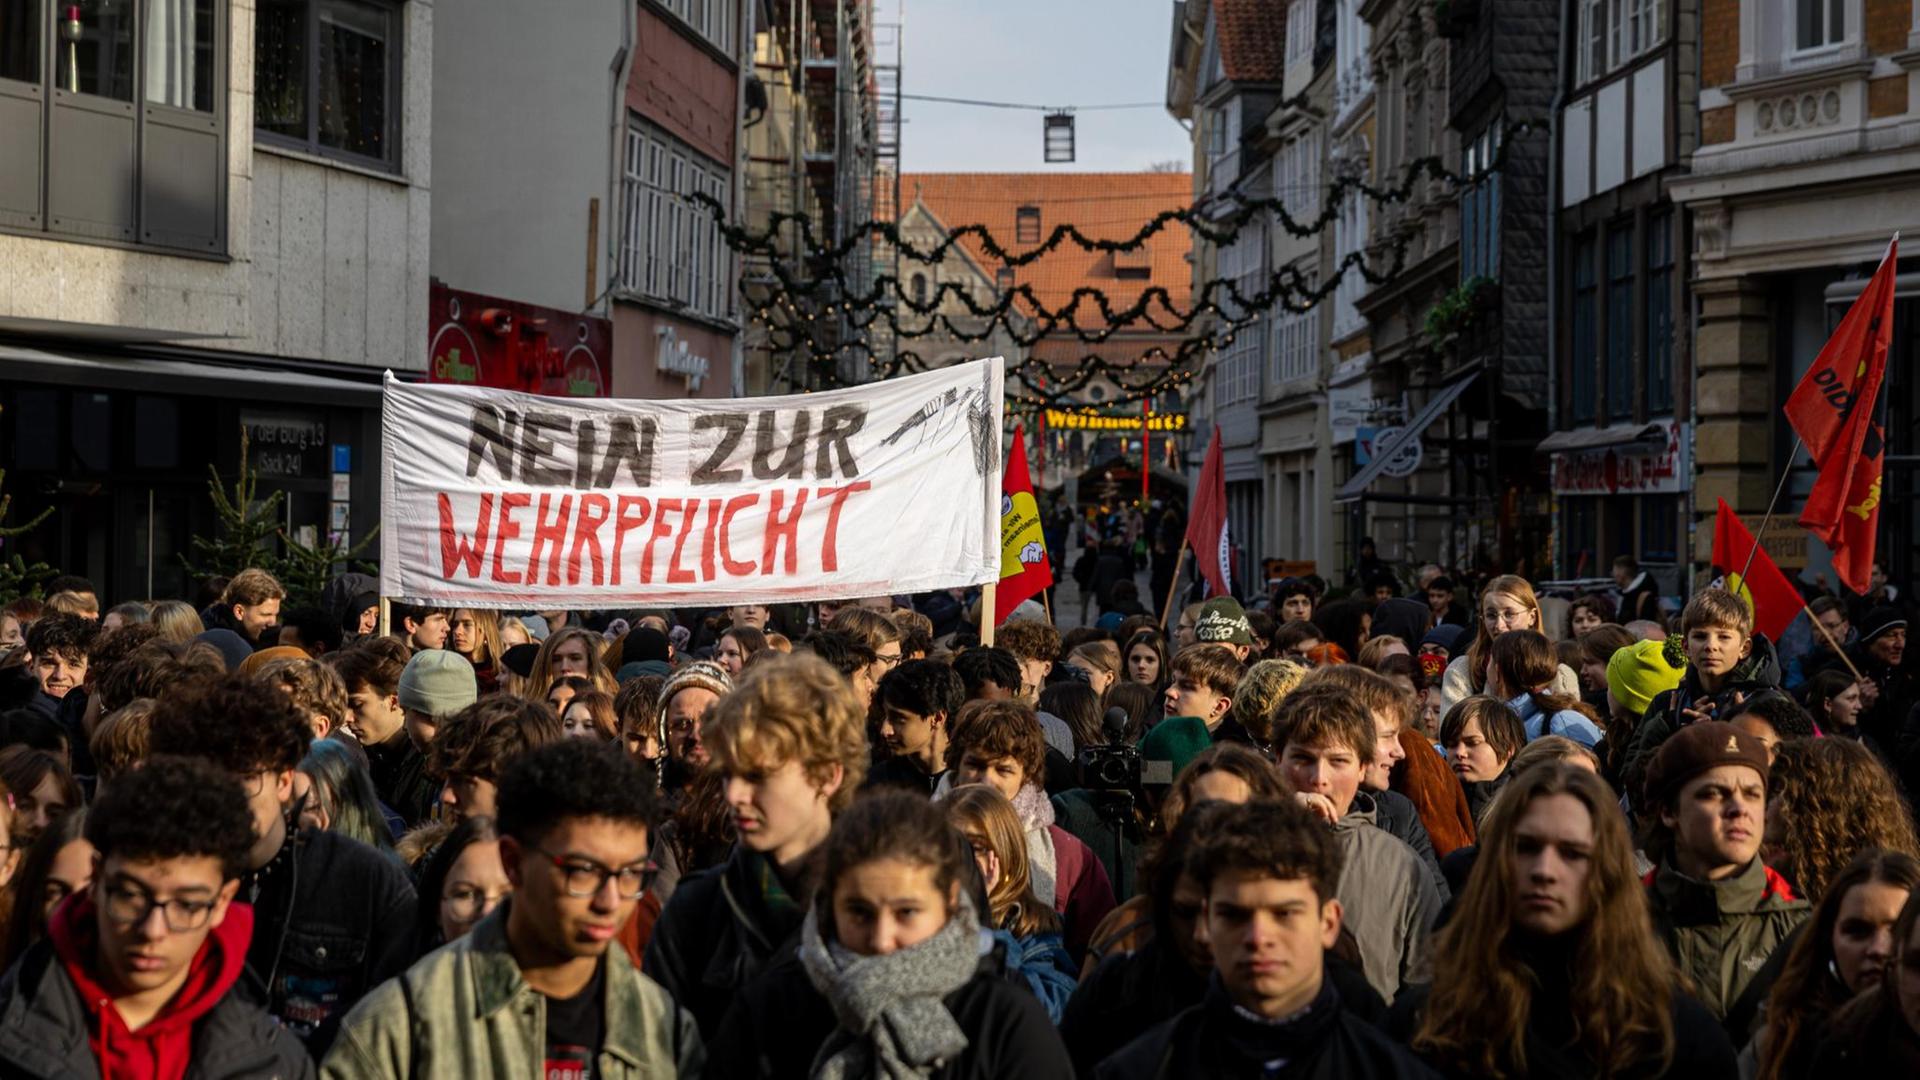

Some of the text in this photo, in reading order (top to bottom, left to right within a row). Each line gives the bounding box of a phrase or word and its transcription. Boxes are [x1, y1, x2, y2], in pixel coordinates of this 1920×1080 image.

[280, 423, 307, 450] Burg
[310, 422, 325, 447] 13
[466, 402, 869, 489] NEIN ZUR
[438, 481, 871, 586] WEHRPFLICHT
